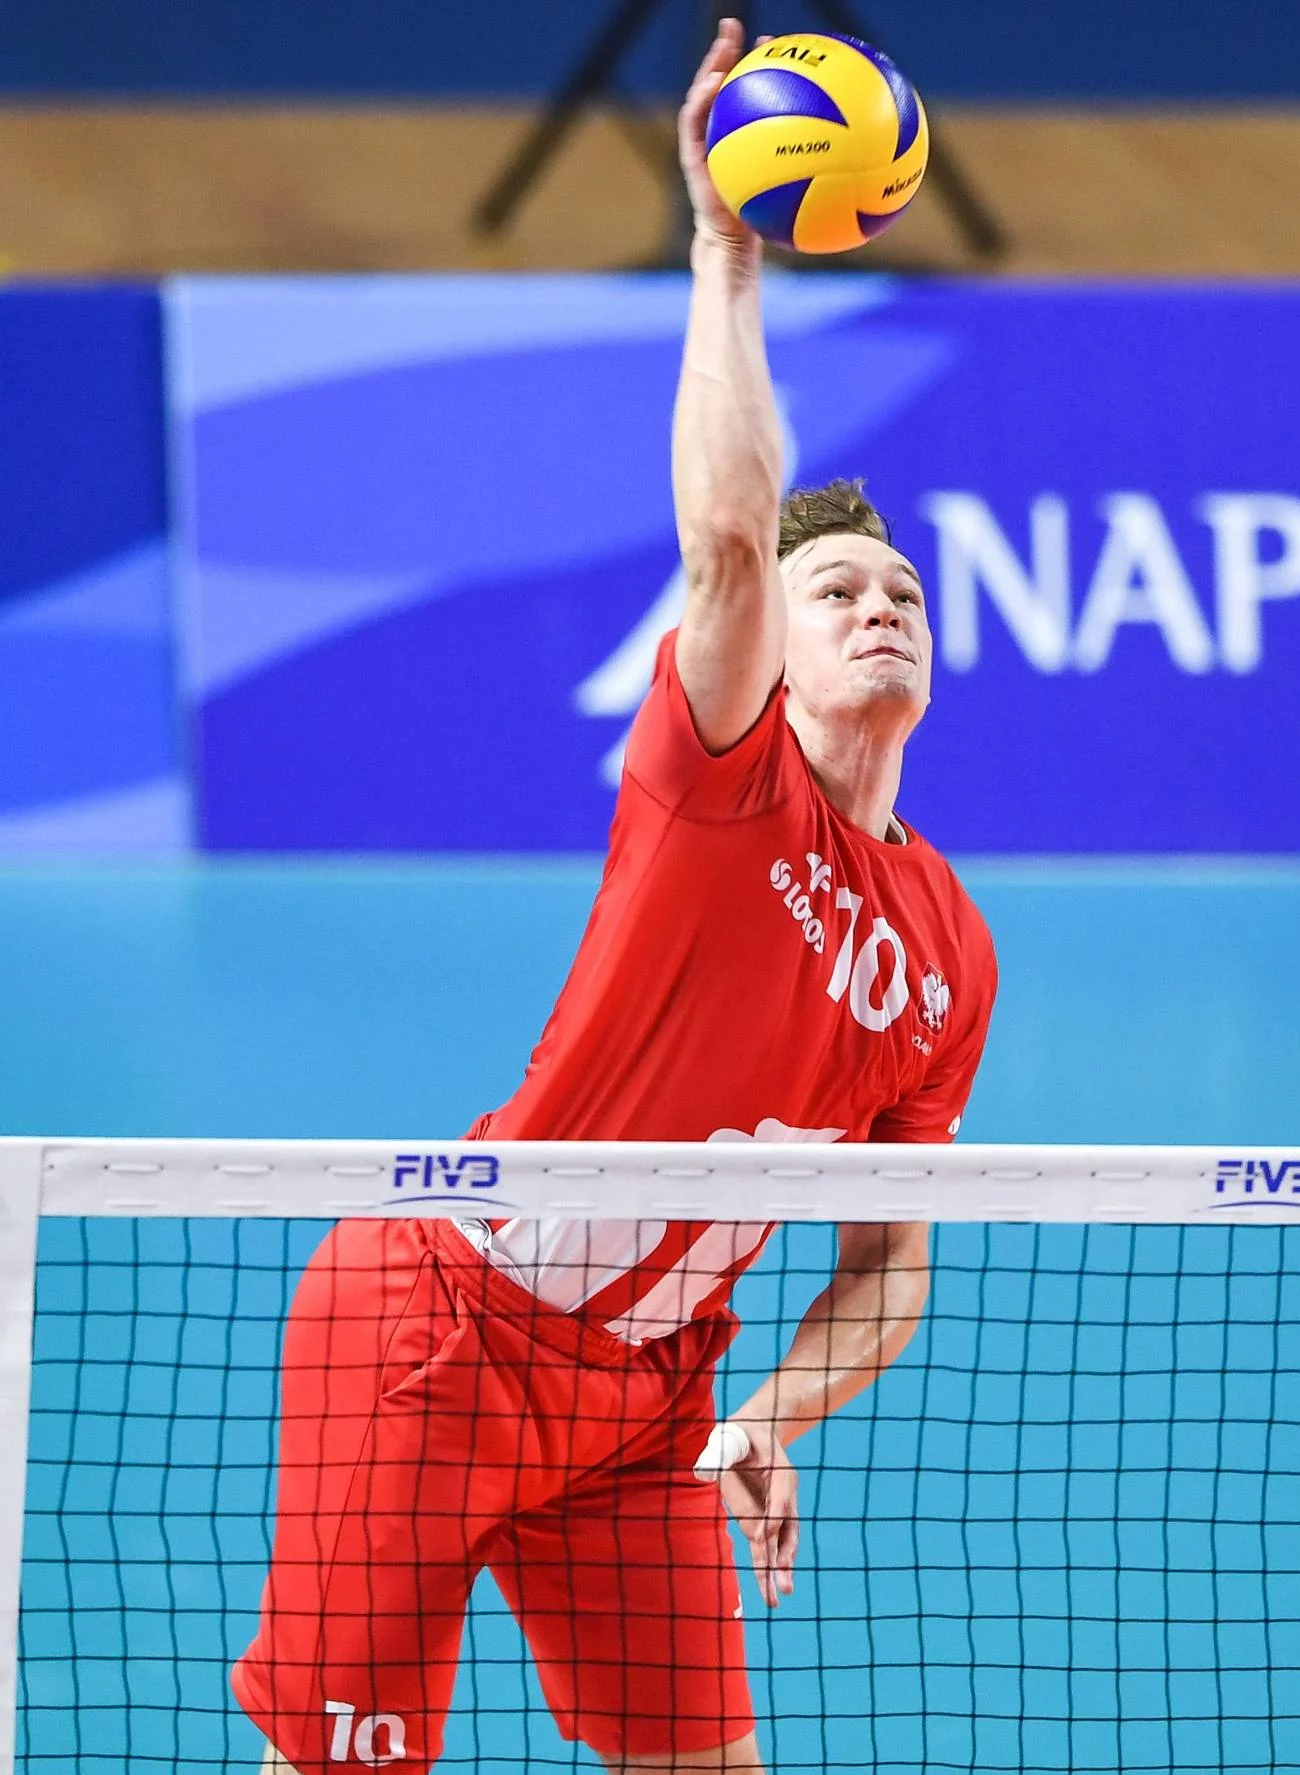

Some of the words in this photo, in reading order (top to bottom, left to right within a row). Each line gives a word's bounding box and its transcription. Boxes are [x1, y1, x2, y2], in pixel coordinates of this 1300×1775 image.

[775, 140, 831, 157] MVA200
[826, 887, 910, 1032] 10
[393, 1155, 499, 1188] FIVB
[325, 1700, 406, 1768] 10
